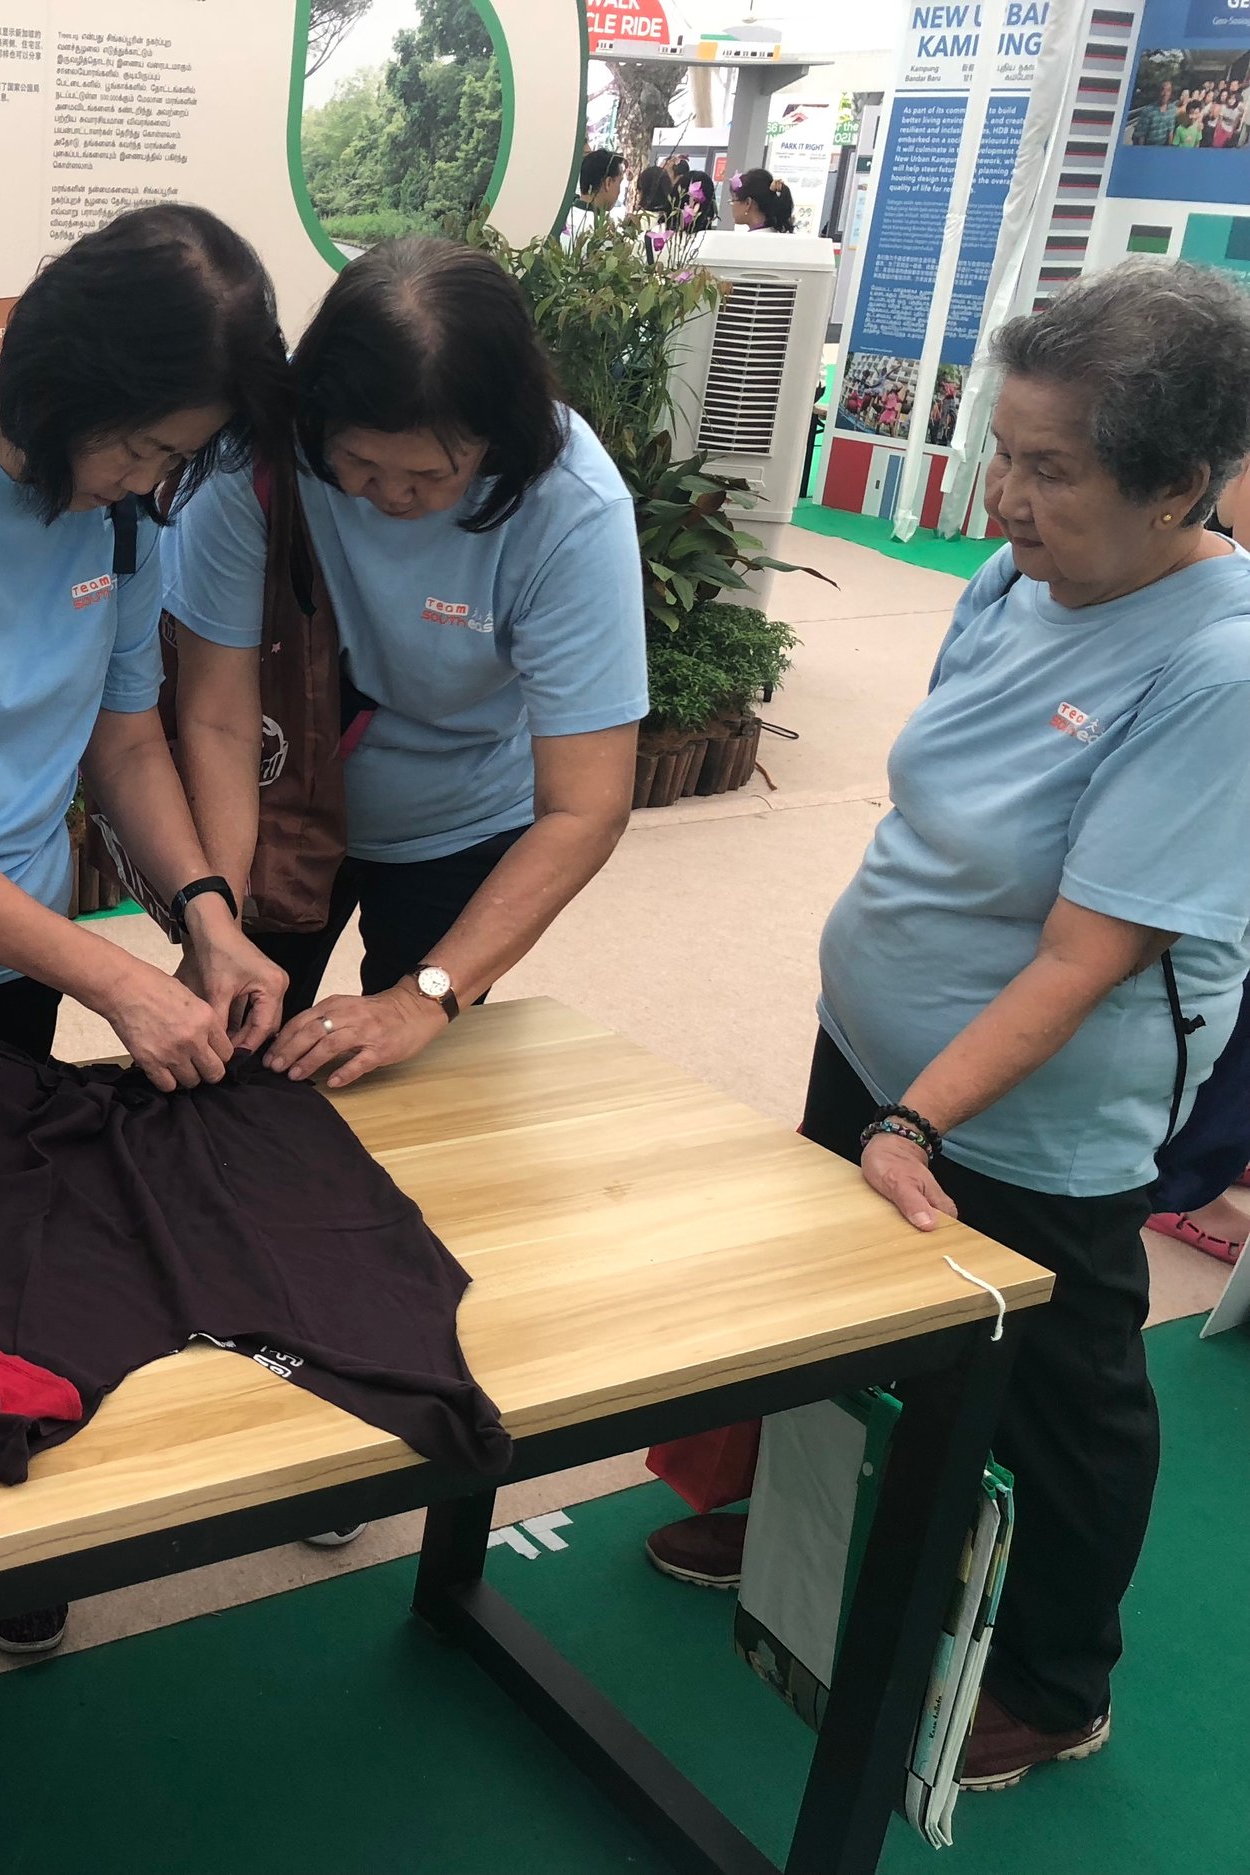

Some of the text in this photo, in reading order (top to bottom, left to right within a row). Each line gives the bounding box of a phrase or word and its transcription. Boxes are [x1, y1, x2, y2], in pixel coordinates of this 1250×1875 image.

[587, 12, 663, 37] CLE RIDE
[912, 5, 969, 29] NEW
[910, 65, 939, 73] Kampung
